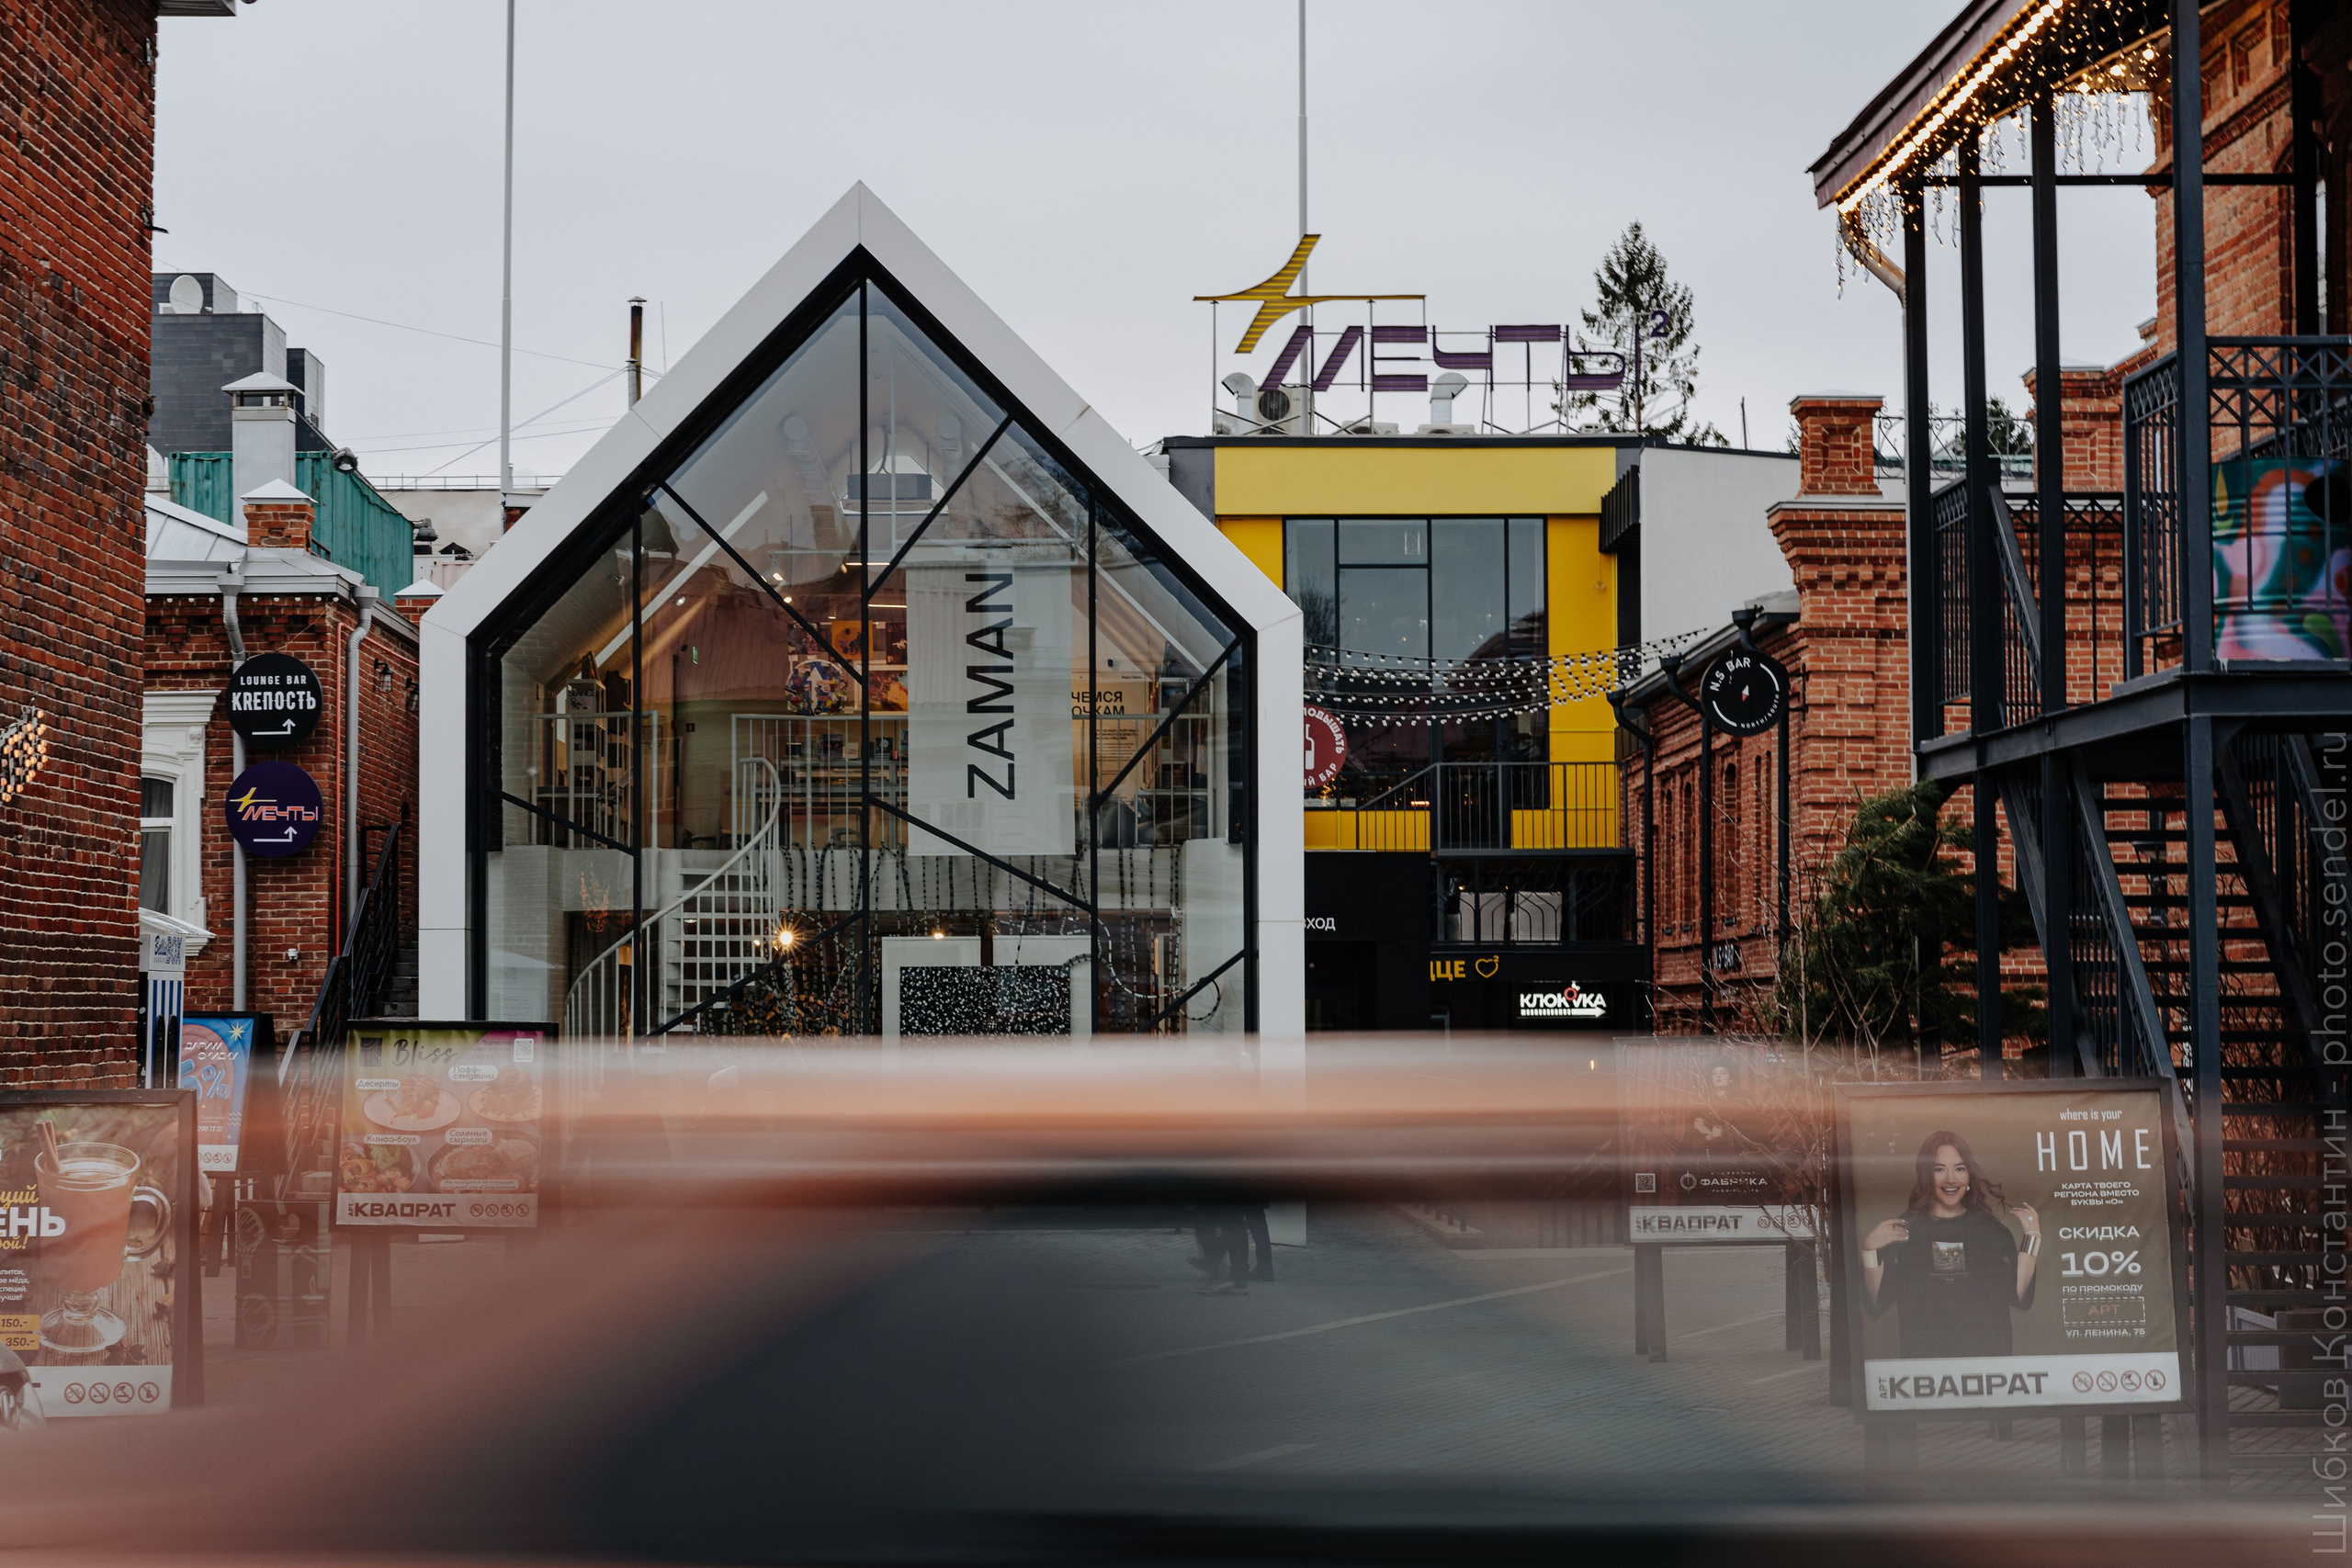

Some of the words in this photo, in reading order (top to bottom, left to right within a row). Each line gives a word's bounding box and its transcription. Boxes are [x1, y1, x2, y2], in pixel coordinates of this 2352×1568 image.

[1258, 324, 1639, 392] МЕЧТЫ
[1725, 657, 1751, 672] BAR
[240, 675, 280, 686] LOUNGE
[287, 675, 307, 685] BAR
[966, 573, 1015, 800] ZAMAN
[1318, 762, 1337, 783] БАР
[242, 806, 319, 821] МЕЧТЫ
[1304, 917, 1336, 931] ХОД
[392, 1038, 459, 1067] Bliss
[453, 1066, 481, 1075] Пафф-
[453, 1072, 494, 1081] сендвичи
[357, 1079, 400, 1089] Десерты
[2060, 1108, 2088, 1121] where
[2090, 1108, 2099, 1120] is
[2101, 1110, 2122, 1122] your
[367, 1134, 417, 1144] Киноа-боул
[449, 1129, 488, 1138] Соленые
[2037, 1128, 2152, 1172] HOME
[1700, 1177, 1769, 1187] ФАБРИКА
[2059, 1225, 2141, 1240] СКИДКА
[0, 1234, 29, 1249] ой!
[2061, 1250, 2142, 1277] 10%
[2080, 1284, 2143, 1293] ПРОМОКОДУ
[2088, 1304, 2120, 1315] АРТ
[2066, 1329, 2083, 1337] УЛ.
[2085, 1328, 2132, 1337] ЛЕНИНА,
[2133, 1328, 2146, 1337] 75
[6, 1337, 35, 1347] 350.-
[1879, 1376, 1888, 1400] АРТ
